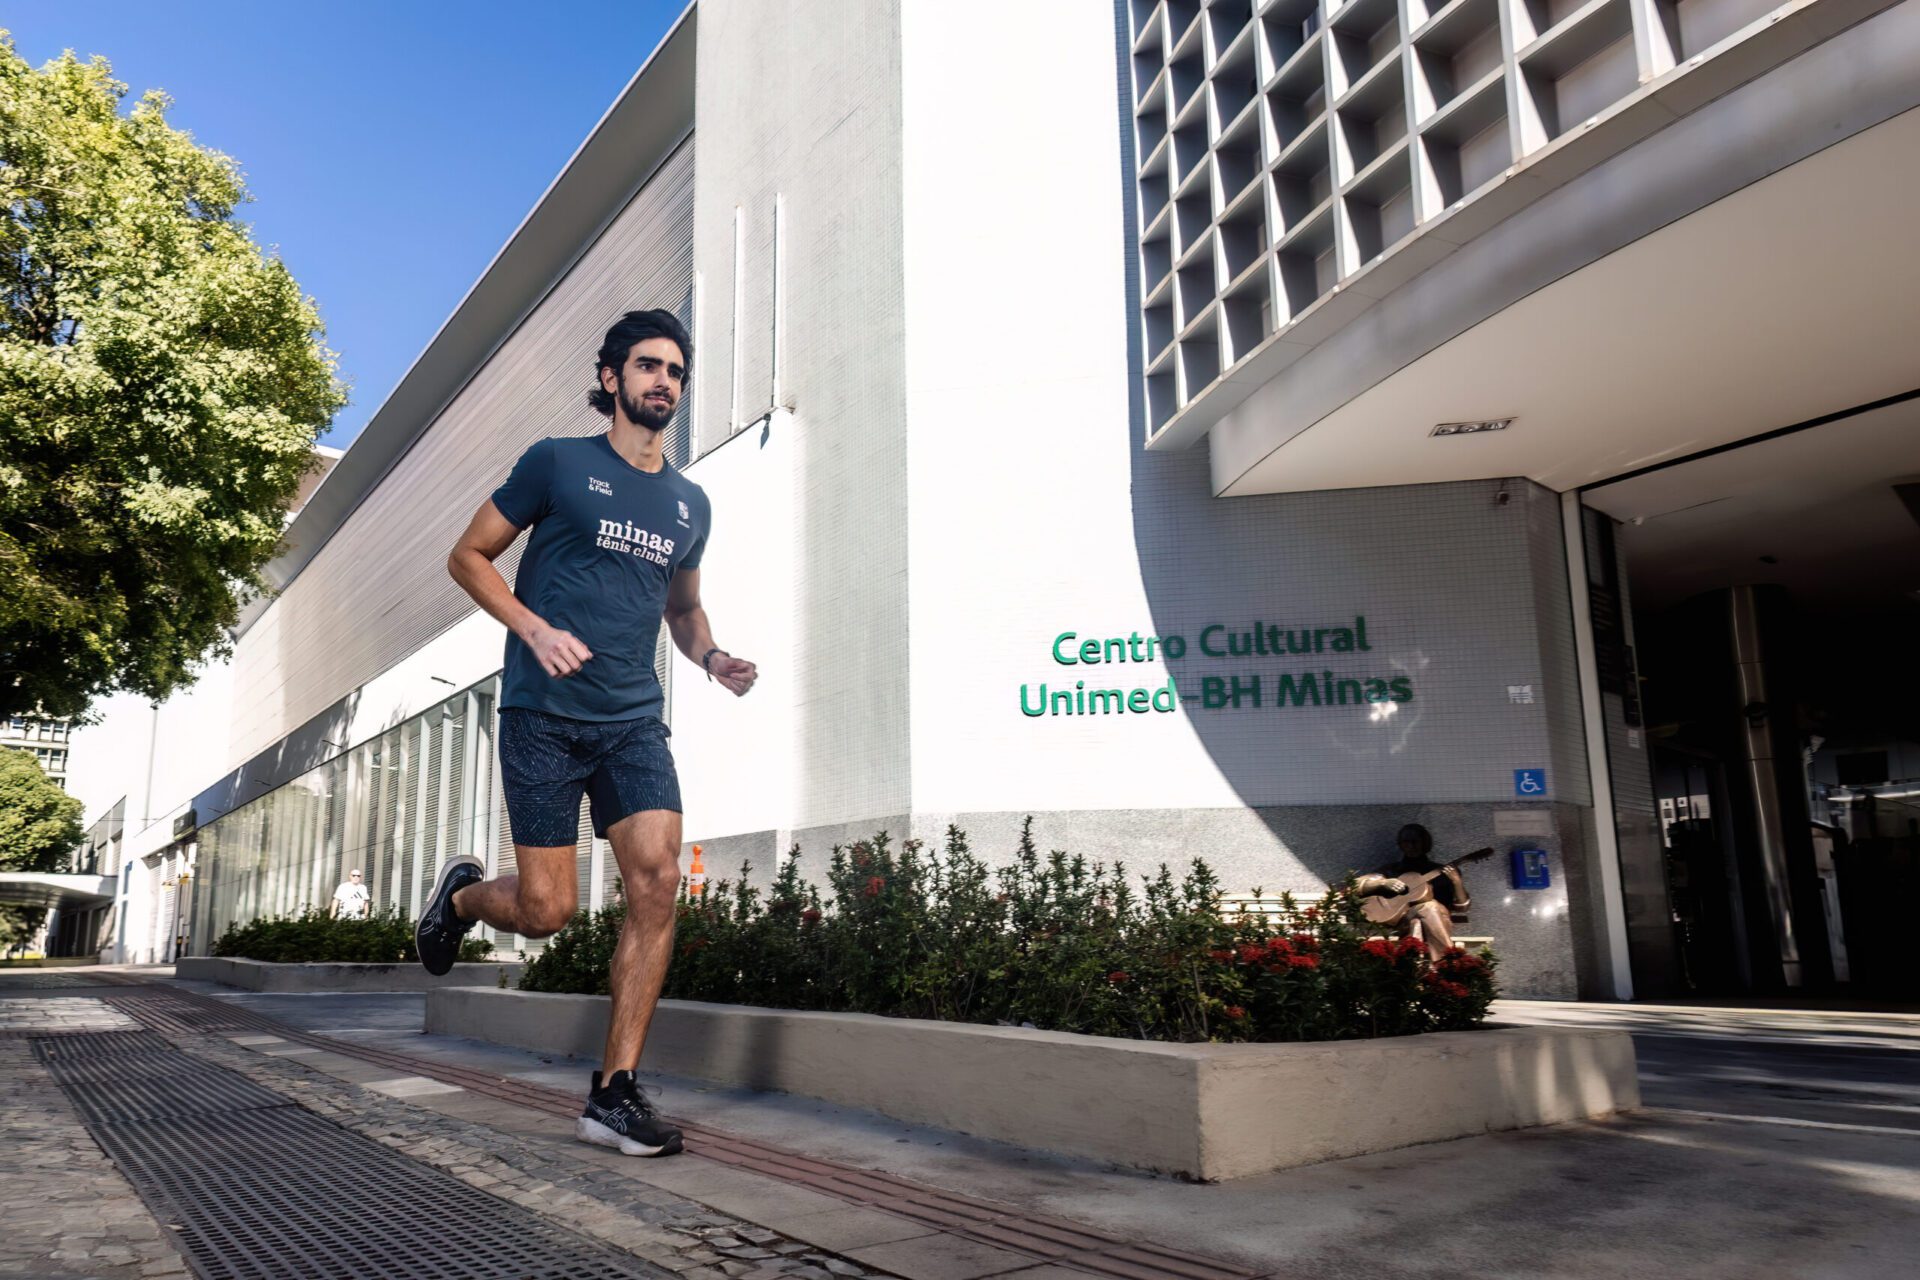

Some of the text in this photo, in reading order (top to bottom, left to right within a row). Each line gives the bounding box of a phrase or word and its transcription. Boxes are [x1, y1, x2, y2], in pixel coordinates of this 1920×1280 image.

[595, 535, 669, 567] tênis clube
[597, 519, 675, 555] minas
[1053, 615, 1372, 664] Centro Cultural
[1277, 671, 1414, 707] Minas
